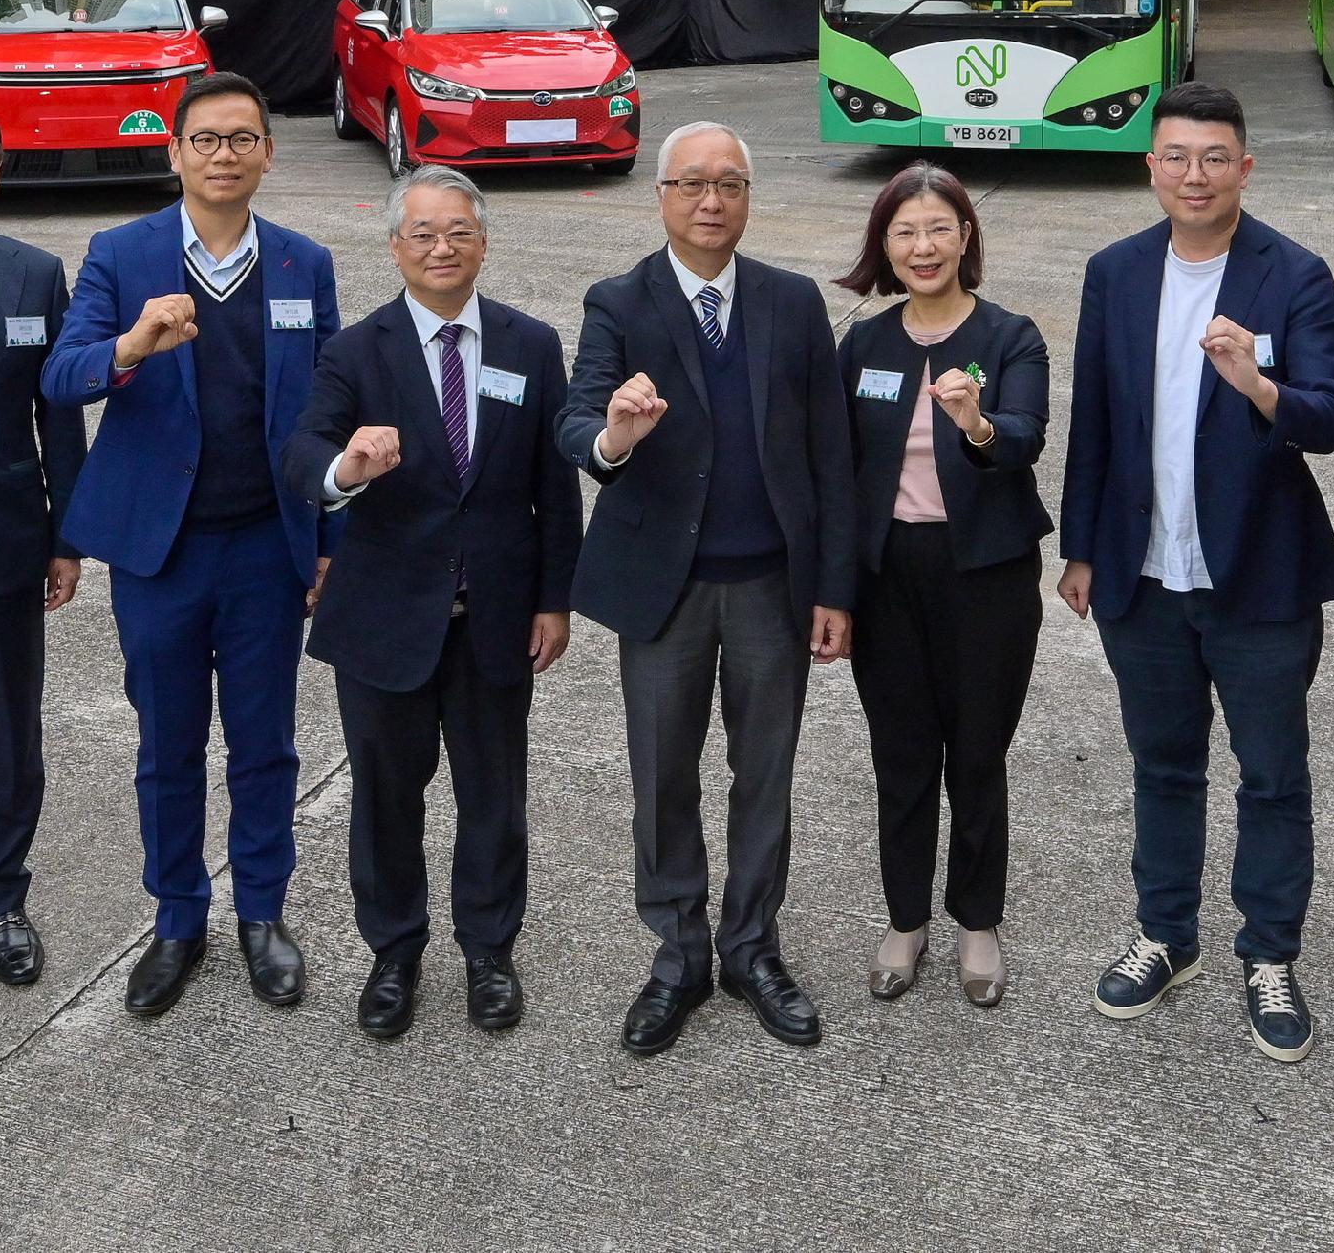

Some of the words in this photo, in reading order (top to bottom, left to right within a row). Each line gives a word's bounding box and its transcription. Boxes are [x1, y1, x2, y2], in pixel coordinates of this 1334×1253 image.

[968, 92, 994, 103] BYD
[138, 118, 147, 128] 6
[953, 128, 972, 140] YB
[977, 128, 1012, 141] 8621
